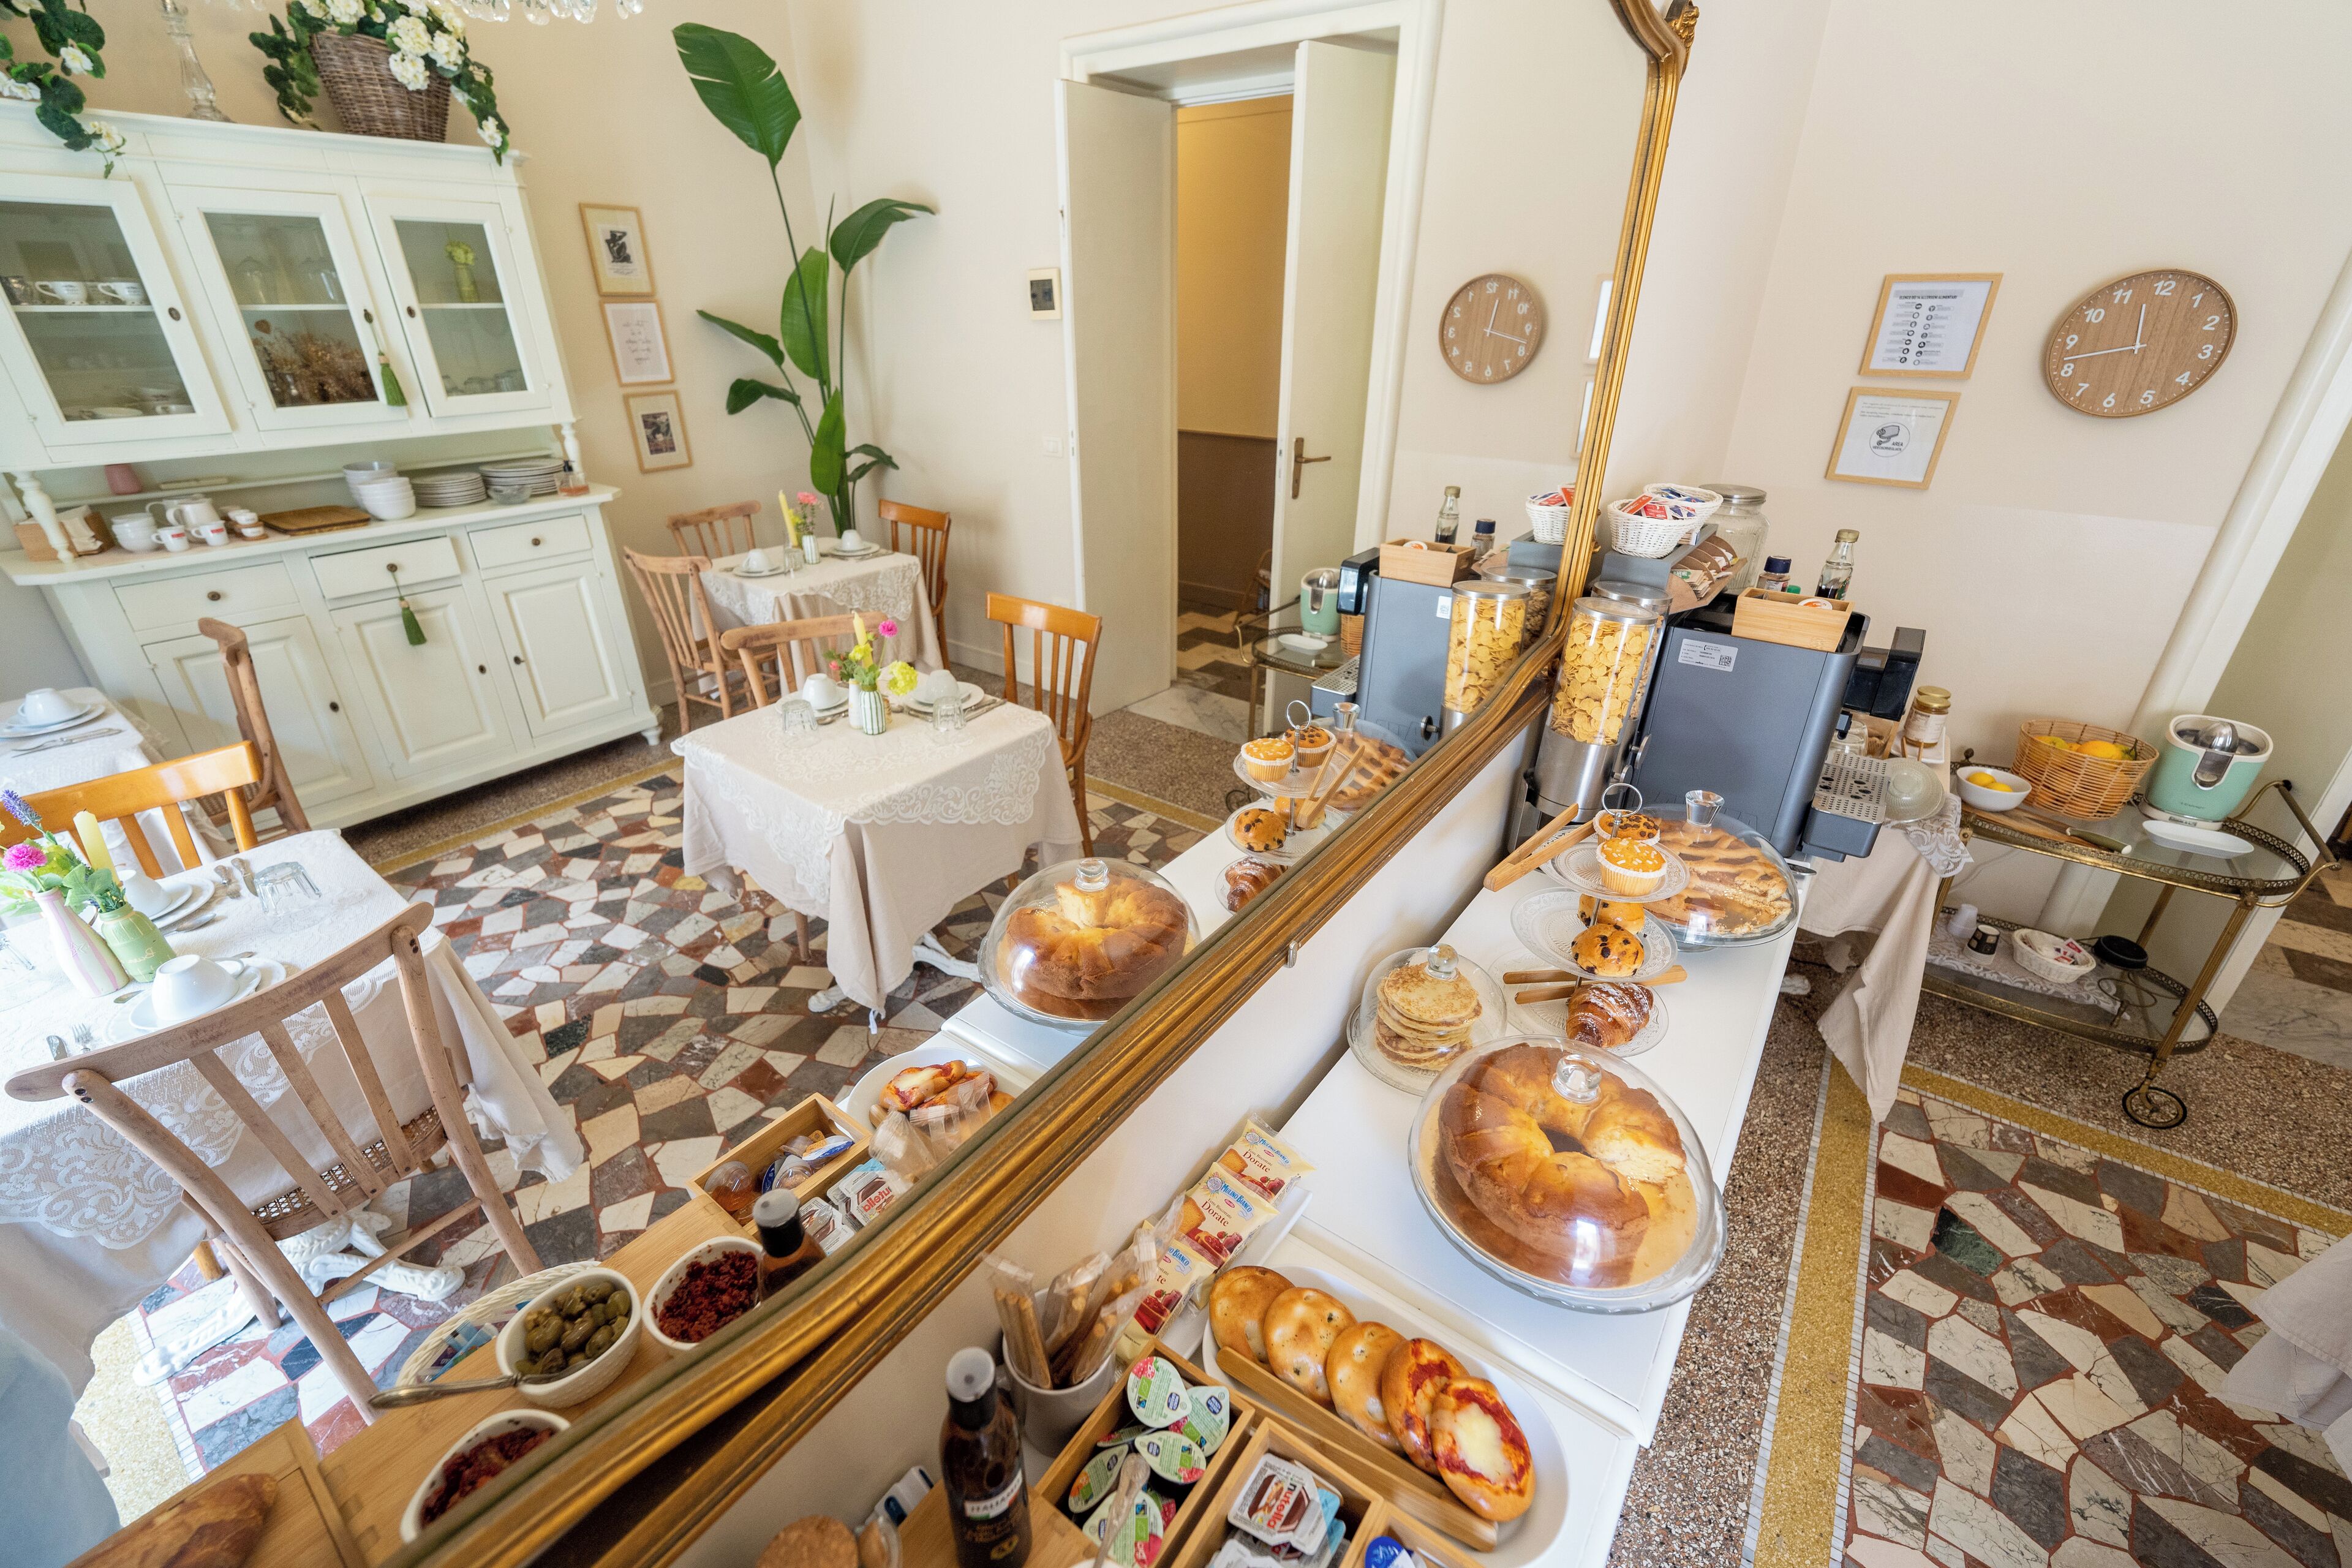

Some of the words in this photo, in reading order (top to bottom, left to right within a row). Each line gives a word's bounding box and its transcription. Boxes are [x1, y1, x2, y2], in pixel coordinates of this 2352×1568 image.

[2154, 281, 2176, 295] 12
[2114, 289, 2132, 304] 11
[2192, 293, 2203, 307] 1
[2084, 309, 2105, 323] 10
[2203, 316, 2220, 330] 2
[2066, 334, 2078, 350] 9
[2198, 344, 2213, 359] 3
[2060, 363, 2074, 377] 8
[2176, 371, 2190, 385] 4
[2076, 383, 2089, 396] 7
[2140, 390, 2155, 404] 5
[2103, 393, 2116, 407] 6
[1259, 1139, 1276, 1152] MULINO
[1275, 1150, 1289, 1164] BIANCO
[1243, 1151, 1270, 1172] Dorate
[1221, 1183, 1239, 1199] MULINO
[1237, 1195, 1253, 1212] BIANCO
[1201, 1201, 1229, 1226] Dorate
[1216, 1204, 1232, 1219] Biscottate
[1172, 1249, 1189, 1266] BIANCO
[1267, 1482, 1297, 1529] nutella
